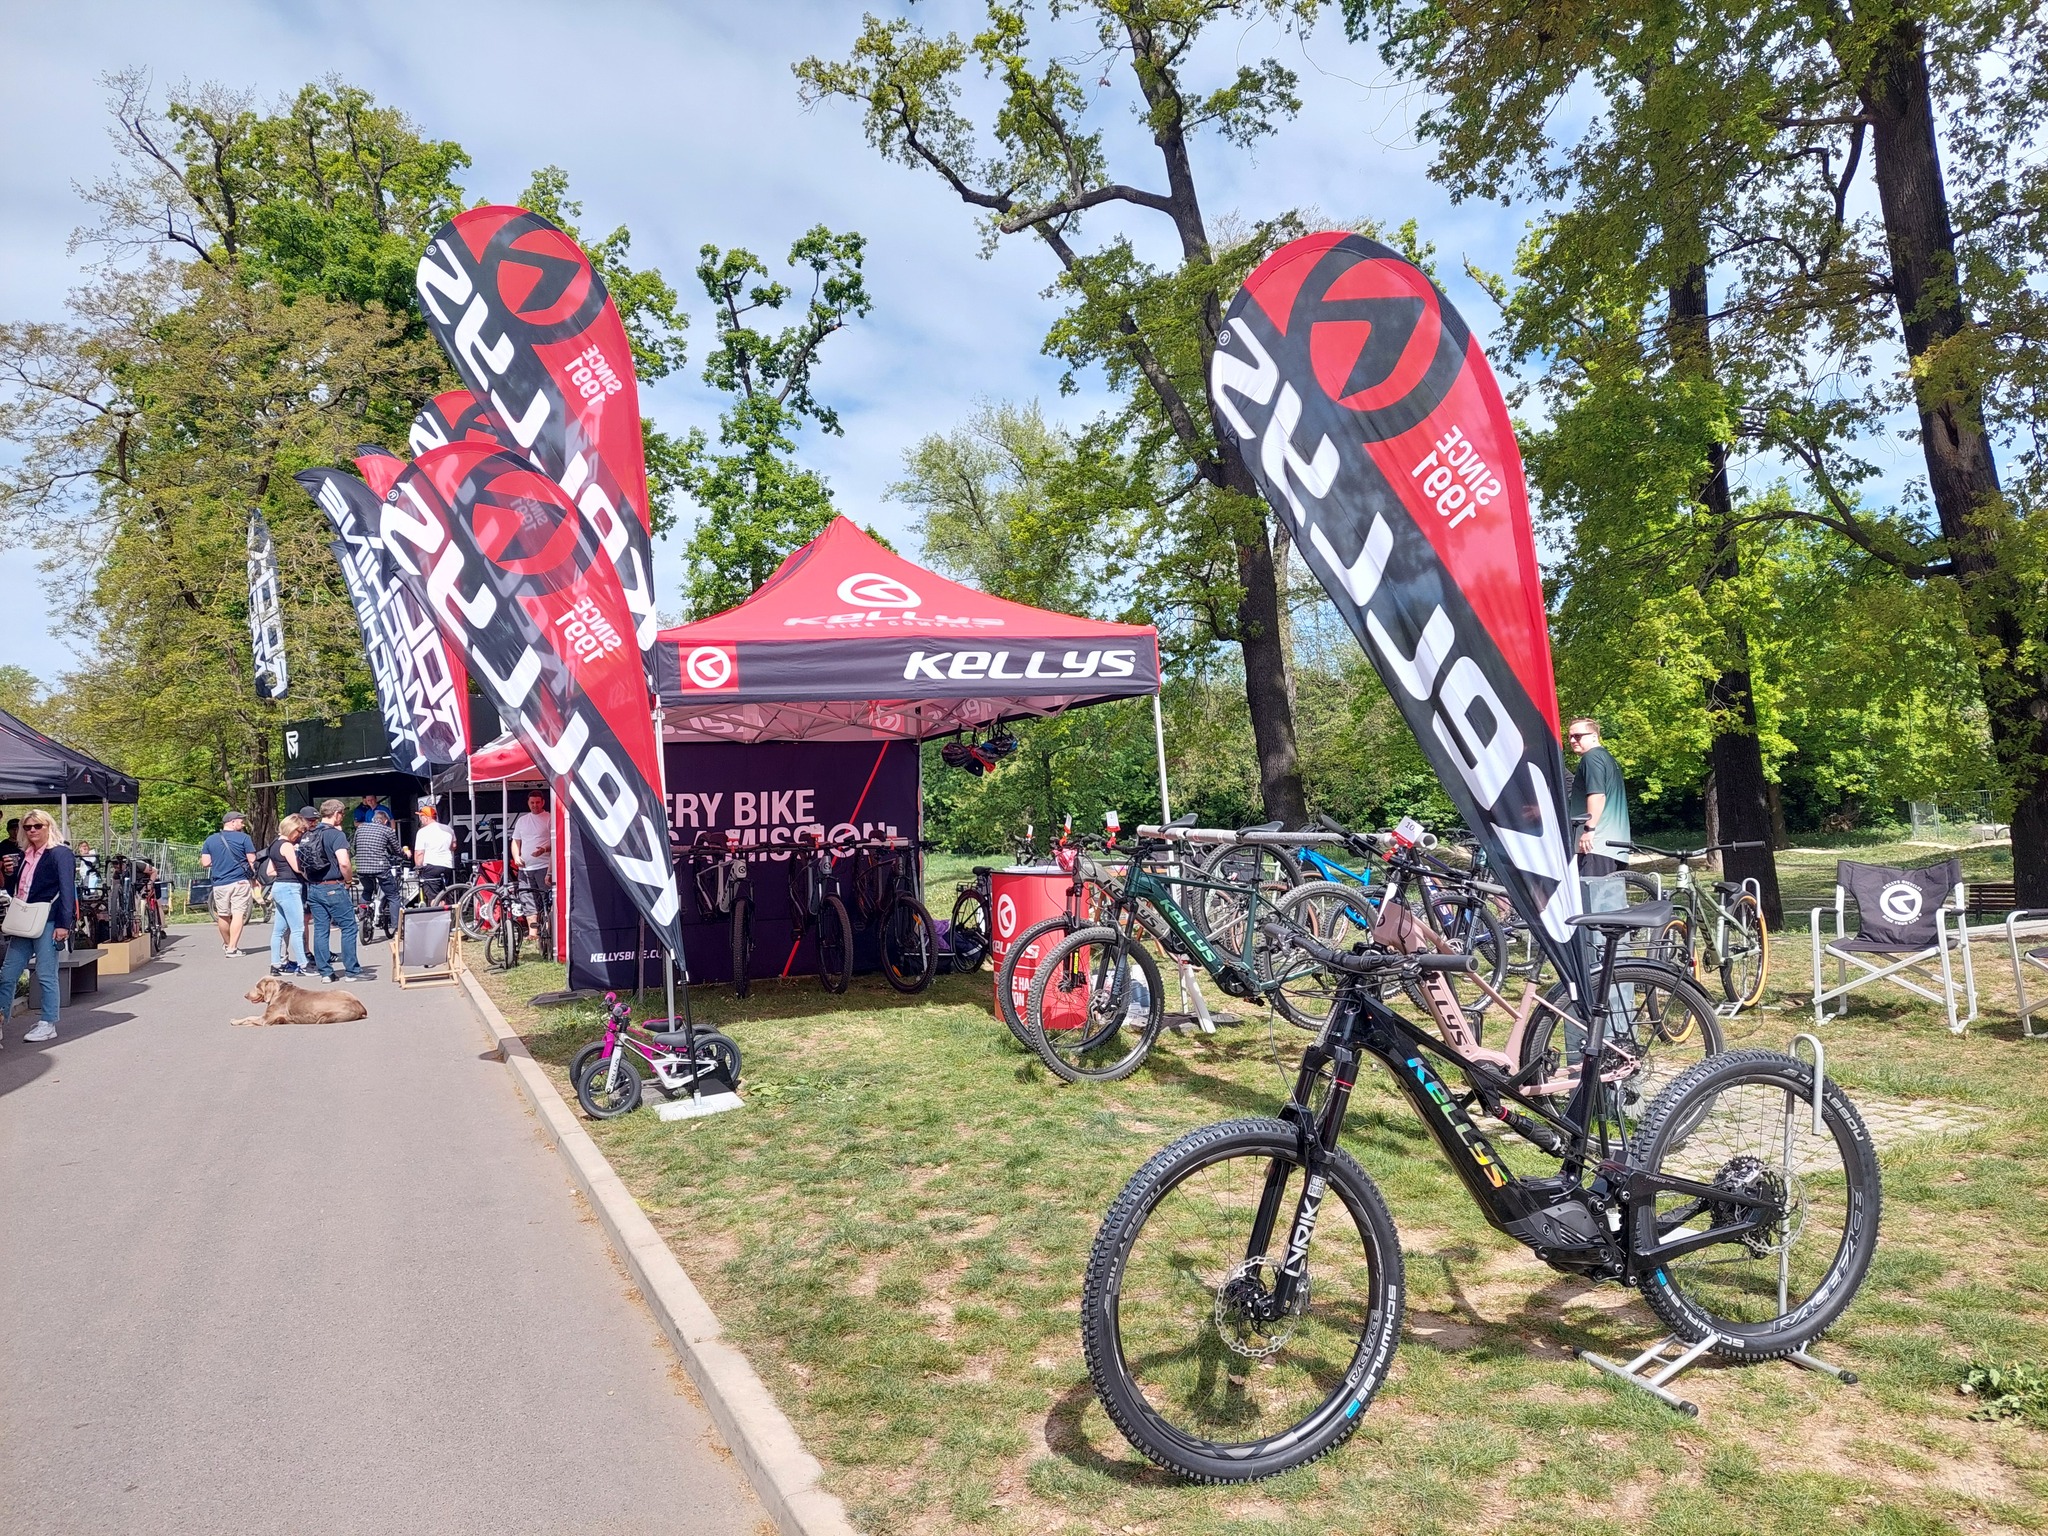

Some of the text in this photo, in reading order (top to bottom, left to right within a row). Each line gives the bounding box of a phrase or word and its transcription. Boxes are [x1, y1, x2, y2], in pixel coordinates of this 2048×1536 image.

[903, 650, 1136, 681] KELLYS
[664, 789, 815, 828] ERY BIKE
[1103, 879, 1160, 928] KEYS
[1160, 899, 1217, 963] KELLYS
[1407, 1057, 1508, 1189] KELLYS
[1824, 1092, 1865, 1142] NOBBY
[1284, 1197, 1320, 1278] LYRIK
[1357, 1285, 1397, 1403] SCHWALBE
